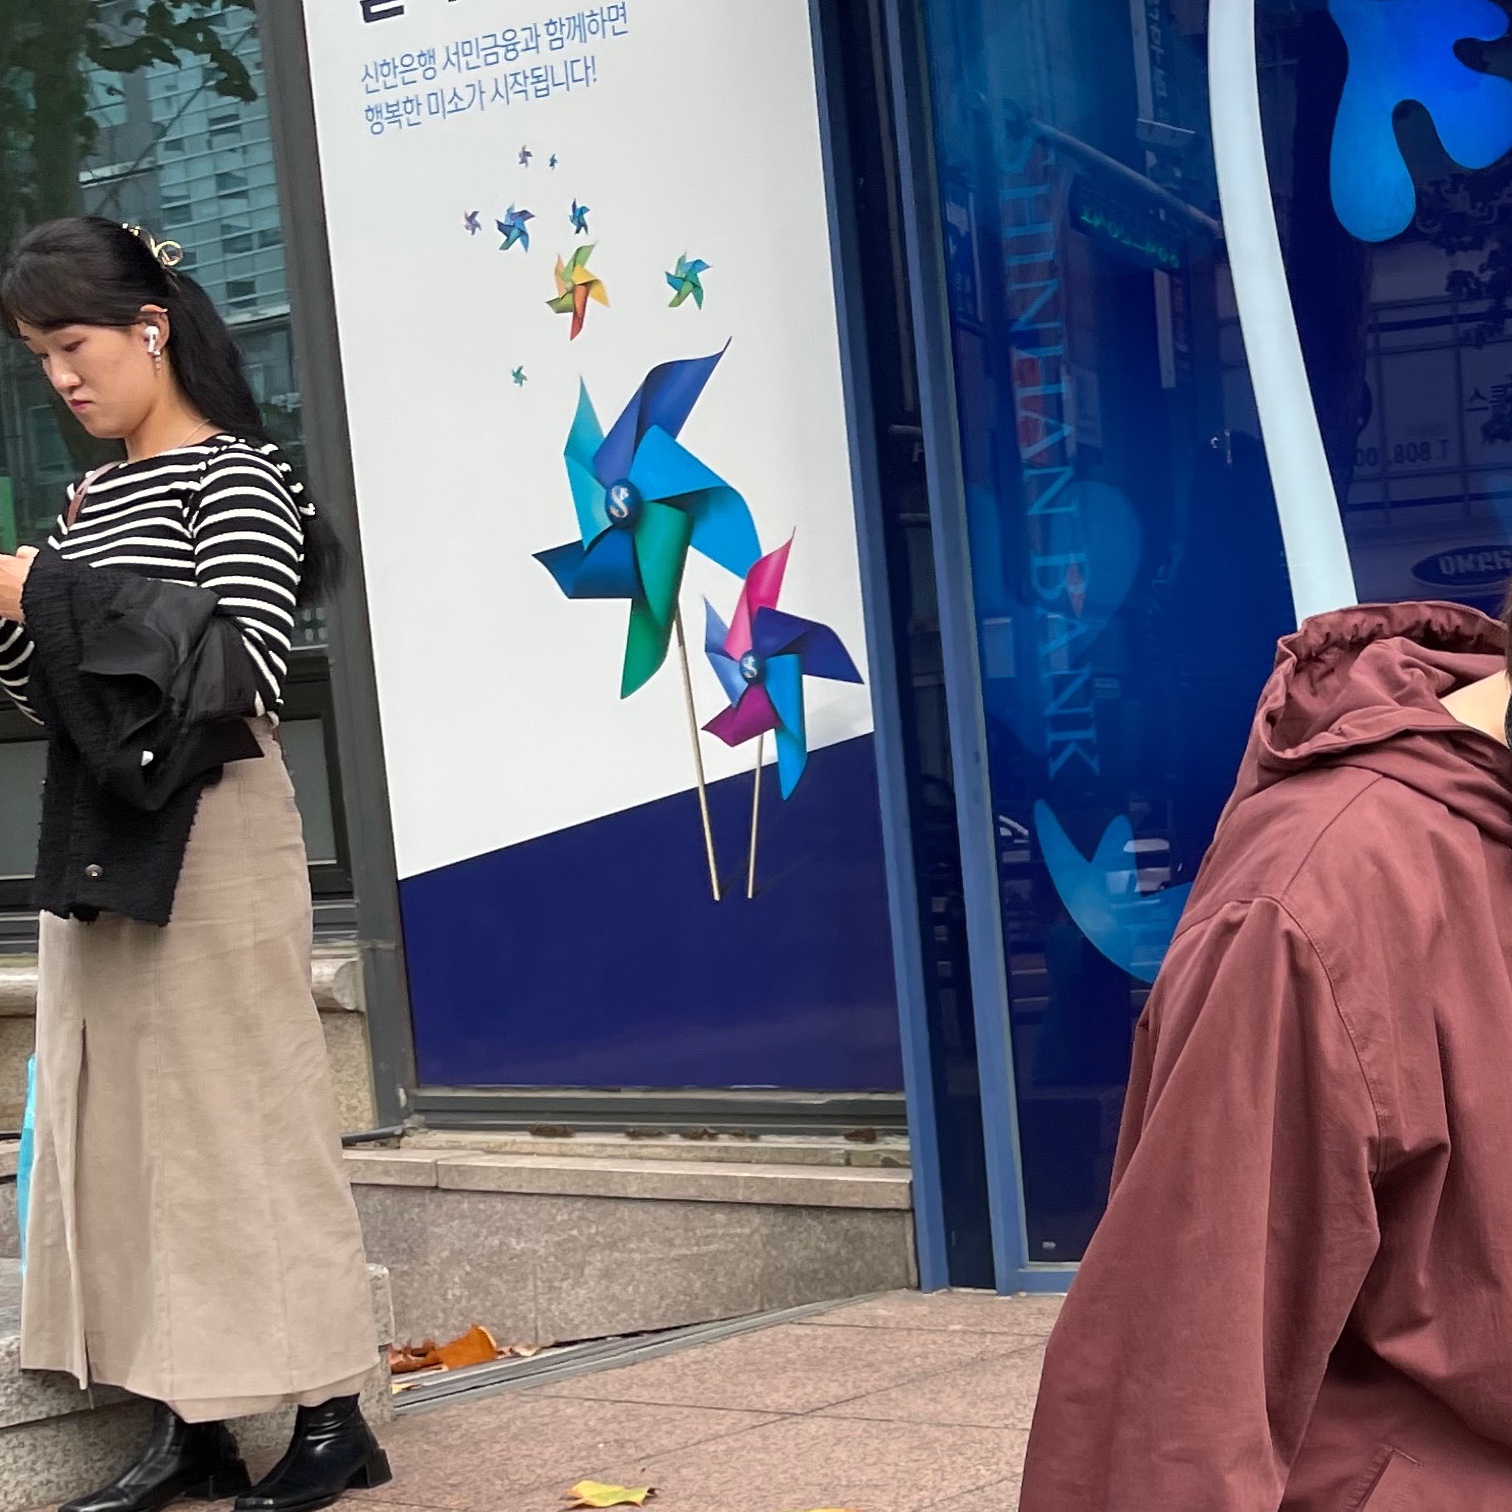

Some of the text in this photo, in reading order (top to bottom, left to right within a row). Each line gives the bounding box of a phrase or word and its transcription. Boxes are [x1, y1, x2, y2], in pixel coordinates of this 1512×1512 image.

[360, 1, 629, 95] 신한은행 서민금융과 함께하면
[364, 55, 598, 136] 행복한 미소가 시작됩니다!
[1030, 552, 1101, 781] BANK
